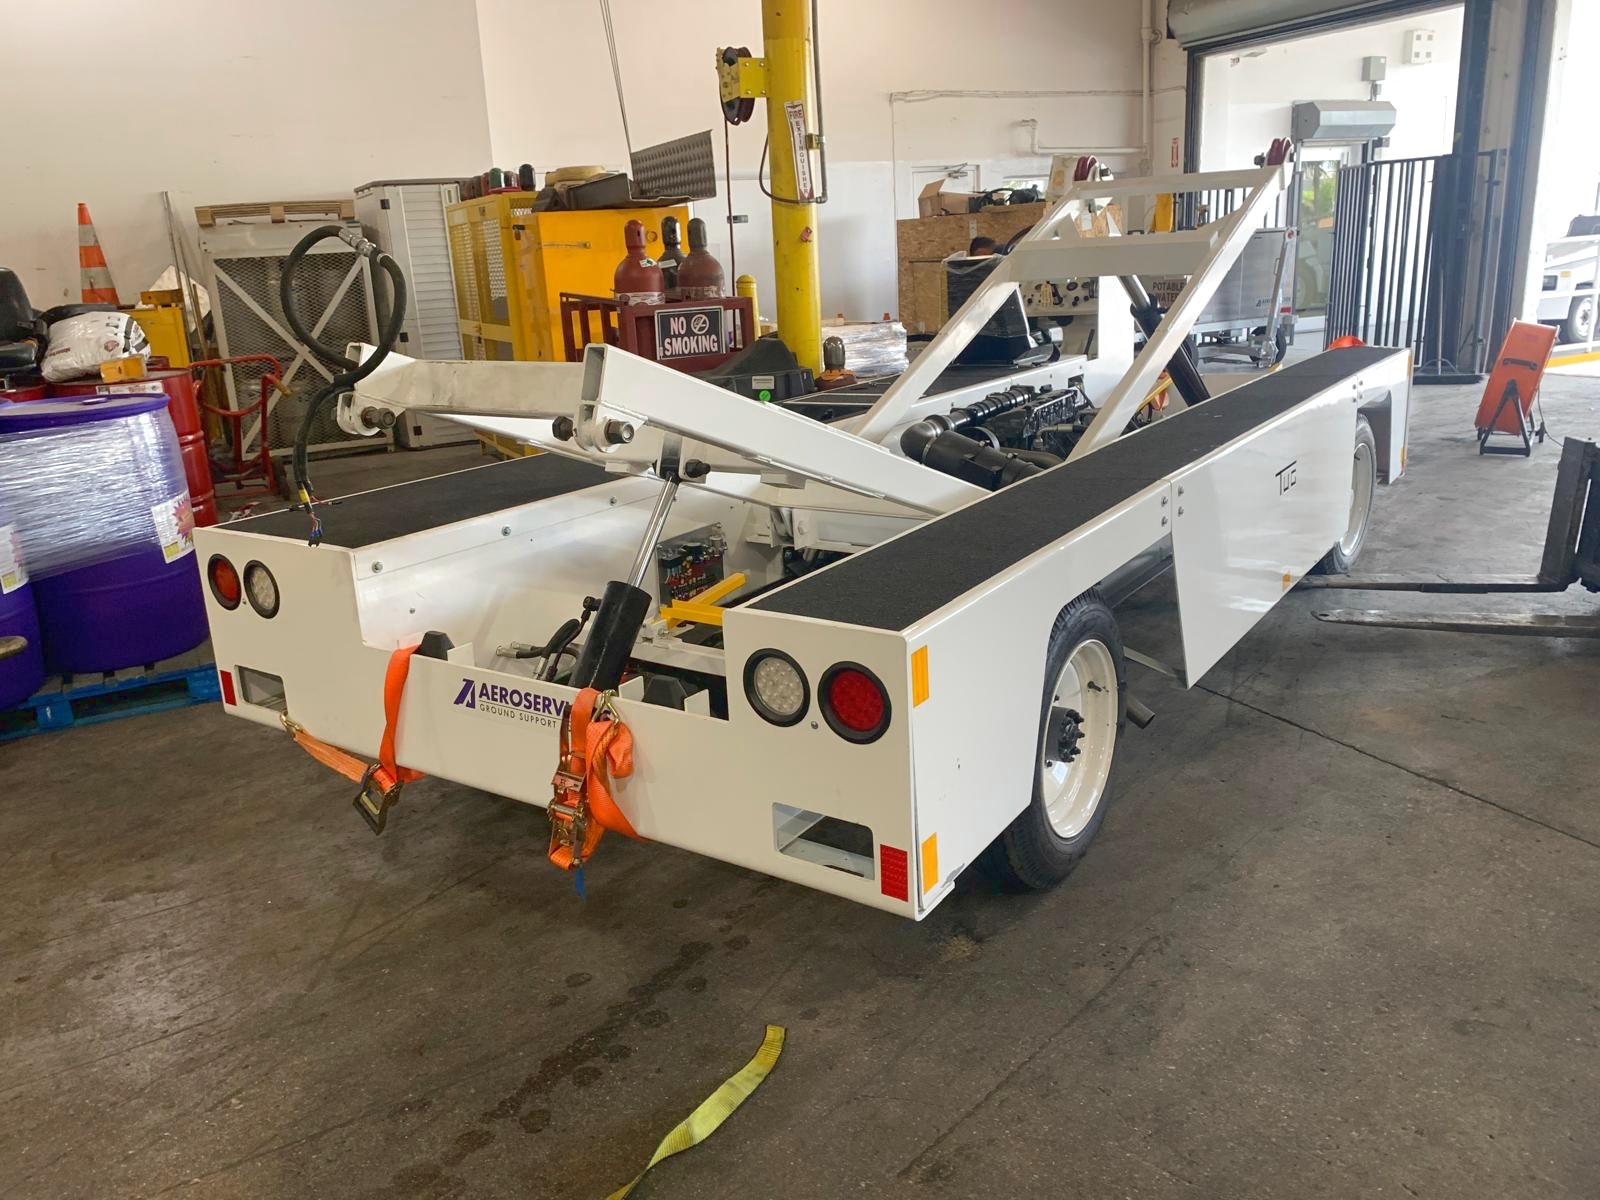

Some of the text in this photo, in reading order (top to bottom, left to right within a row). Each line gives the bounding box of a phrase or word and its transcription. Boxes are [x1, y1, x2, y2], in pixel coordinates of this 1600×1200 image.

[795, 120, 809, 193] EXTINGUISHER
[670, 316, 686, 335] NO
[664, 334, 718, 356] SMOKING
[480, 703, 557, 729] GROUND SUPPORT
